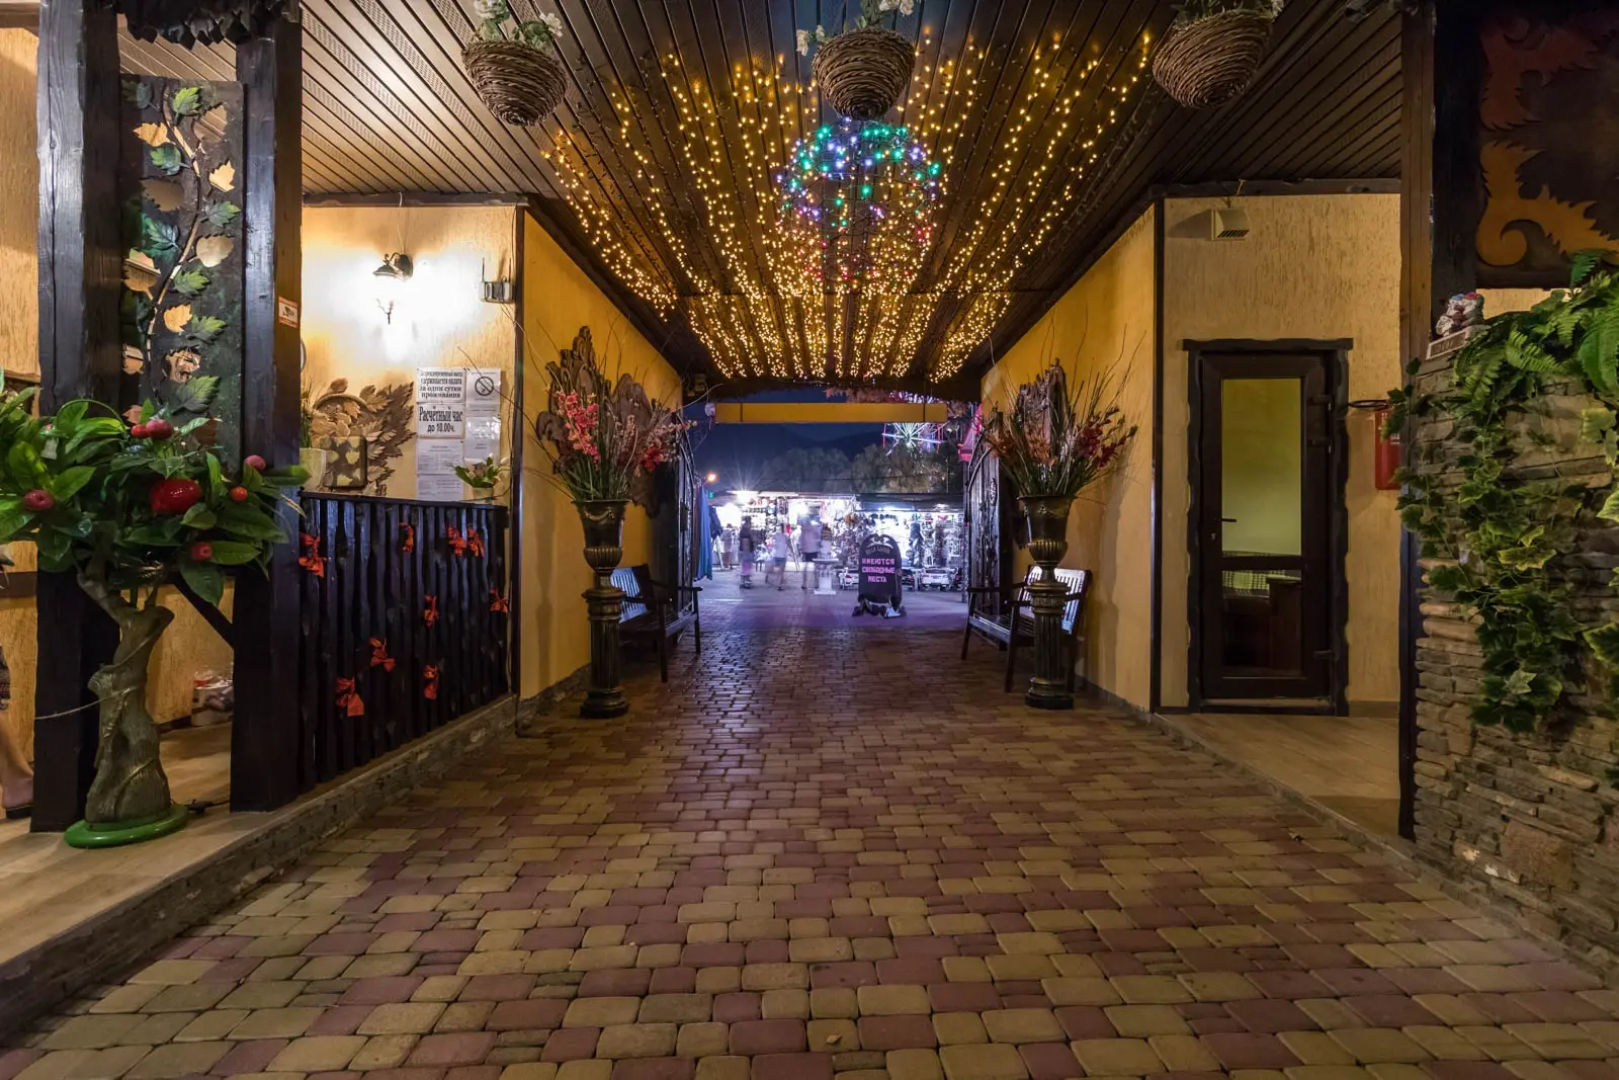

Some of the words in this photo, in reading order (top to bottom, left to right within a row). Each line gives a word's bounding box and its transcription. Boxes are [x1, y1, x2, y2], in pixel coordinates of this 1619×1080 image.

[452, 411, 463, 421] час
[427, 424, 435, 433] до
[867, 575, 887, 583] МЕСТА
